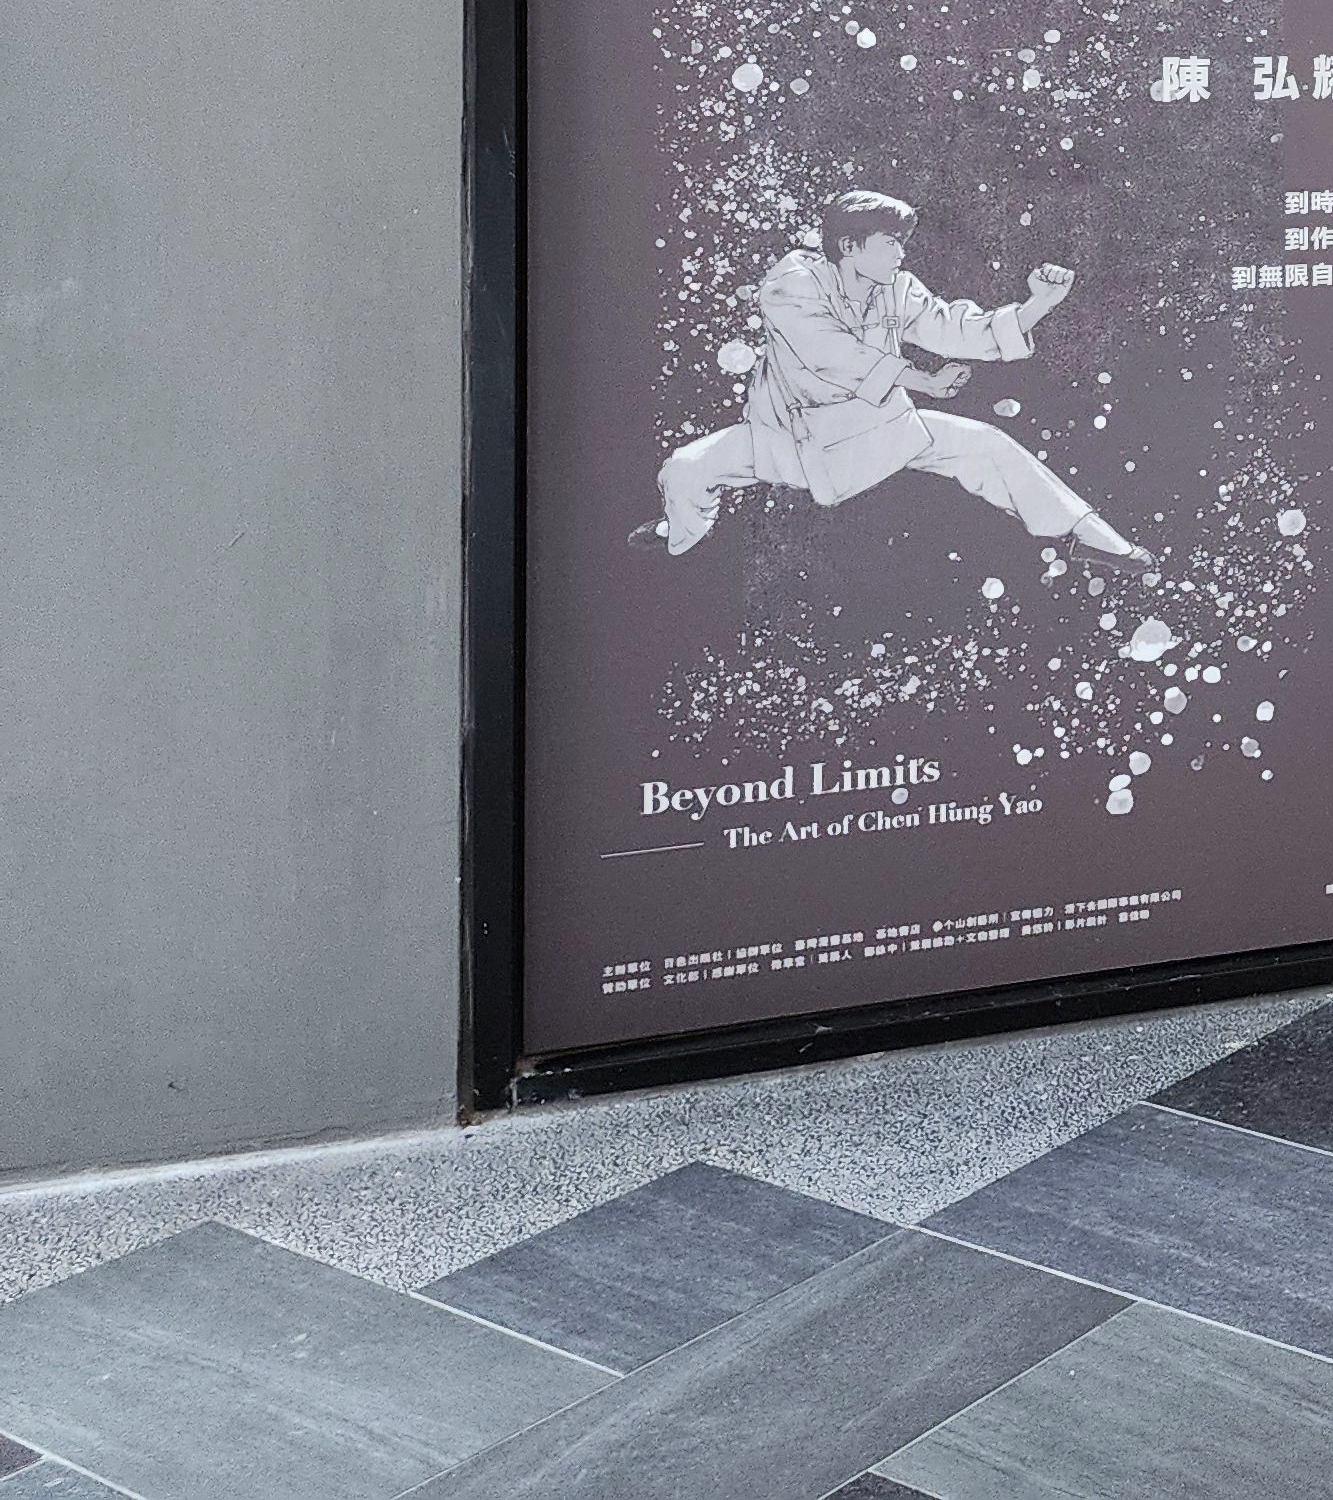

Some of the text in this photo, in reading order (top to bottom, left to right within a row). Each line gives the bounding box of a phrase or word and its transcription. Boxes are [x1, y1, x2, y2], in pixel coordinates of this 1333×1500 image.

[640, 756, 941, 820] Beyond Limits
[723, 791, 1043, 849] The Art of Chen Hung Yao
